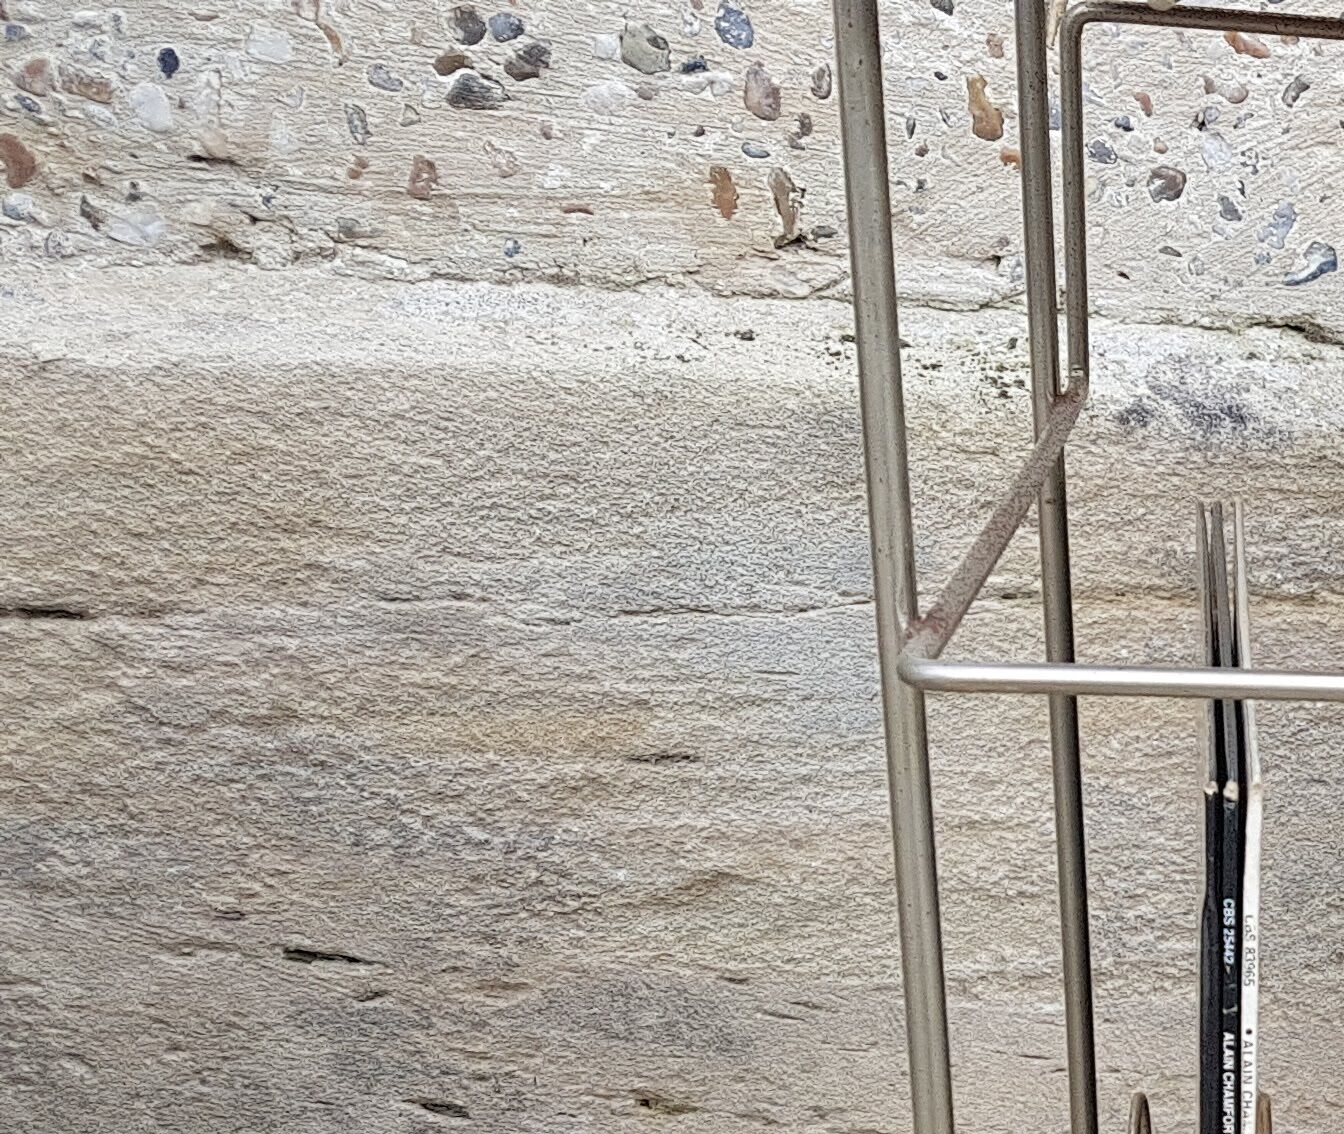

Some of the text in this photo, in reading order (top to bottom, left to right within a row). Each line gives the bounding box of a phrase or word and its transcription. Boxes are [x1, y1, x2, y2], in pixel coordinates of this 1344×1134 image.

[1223, 898, 1236, 926] CBS
[1222, 1032, 1235, 1070] ALAIN
[1242, 1040, 1253, 1084] ALAIN
